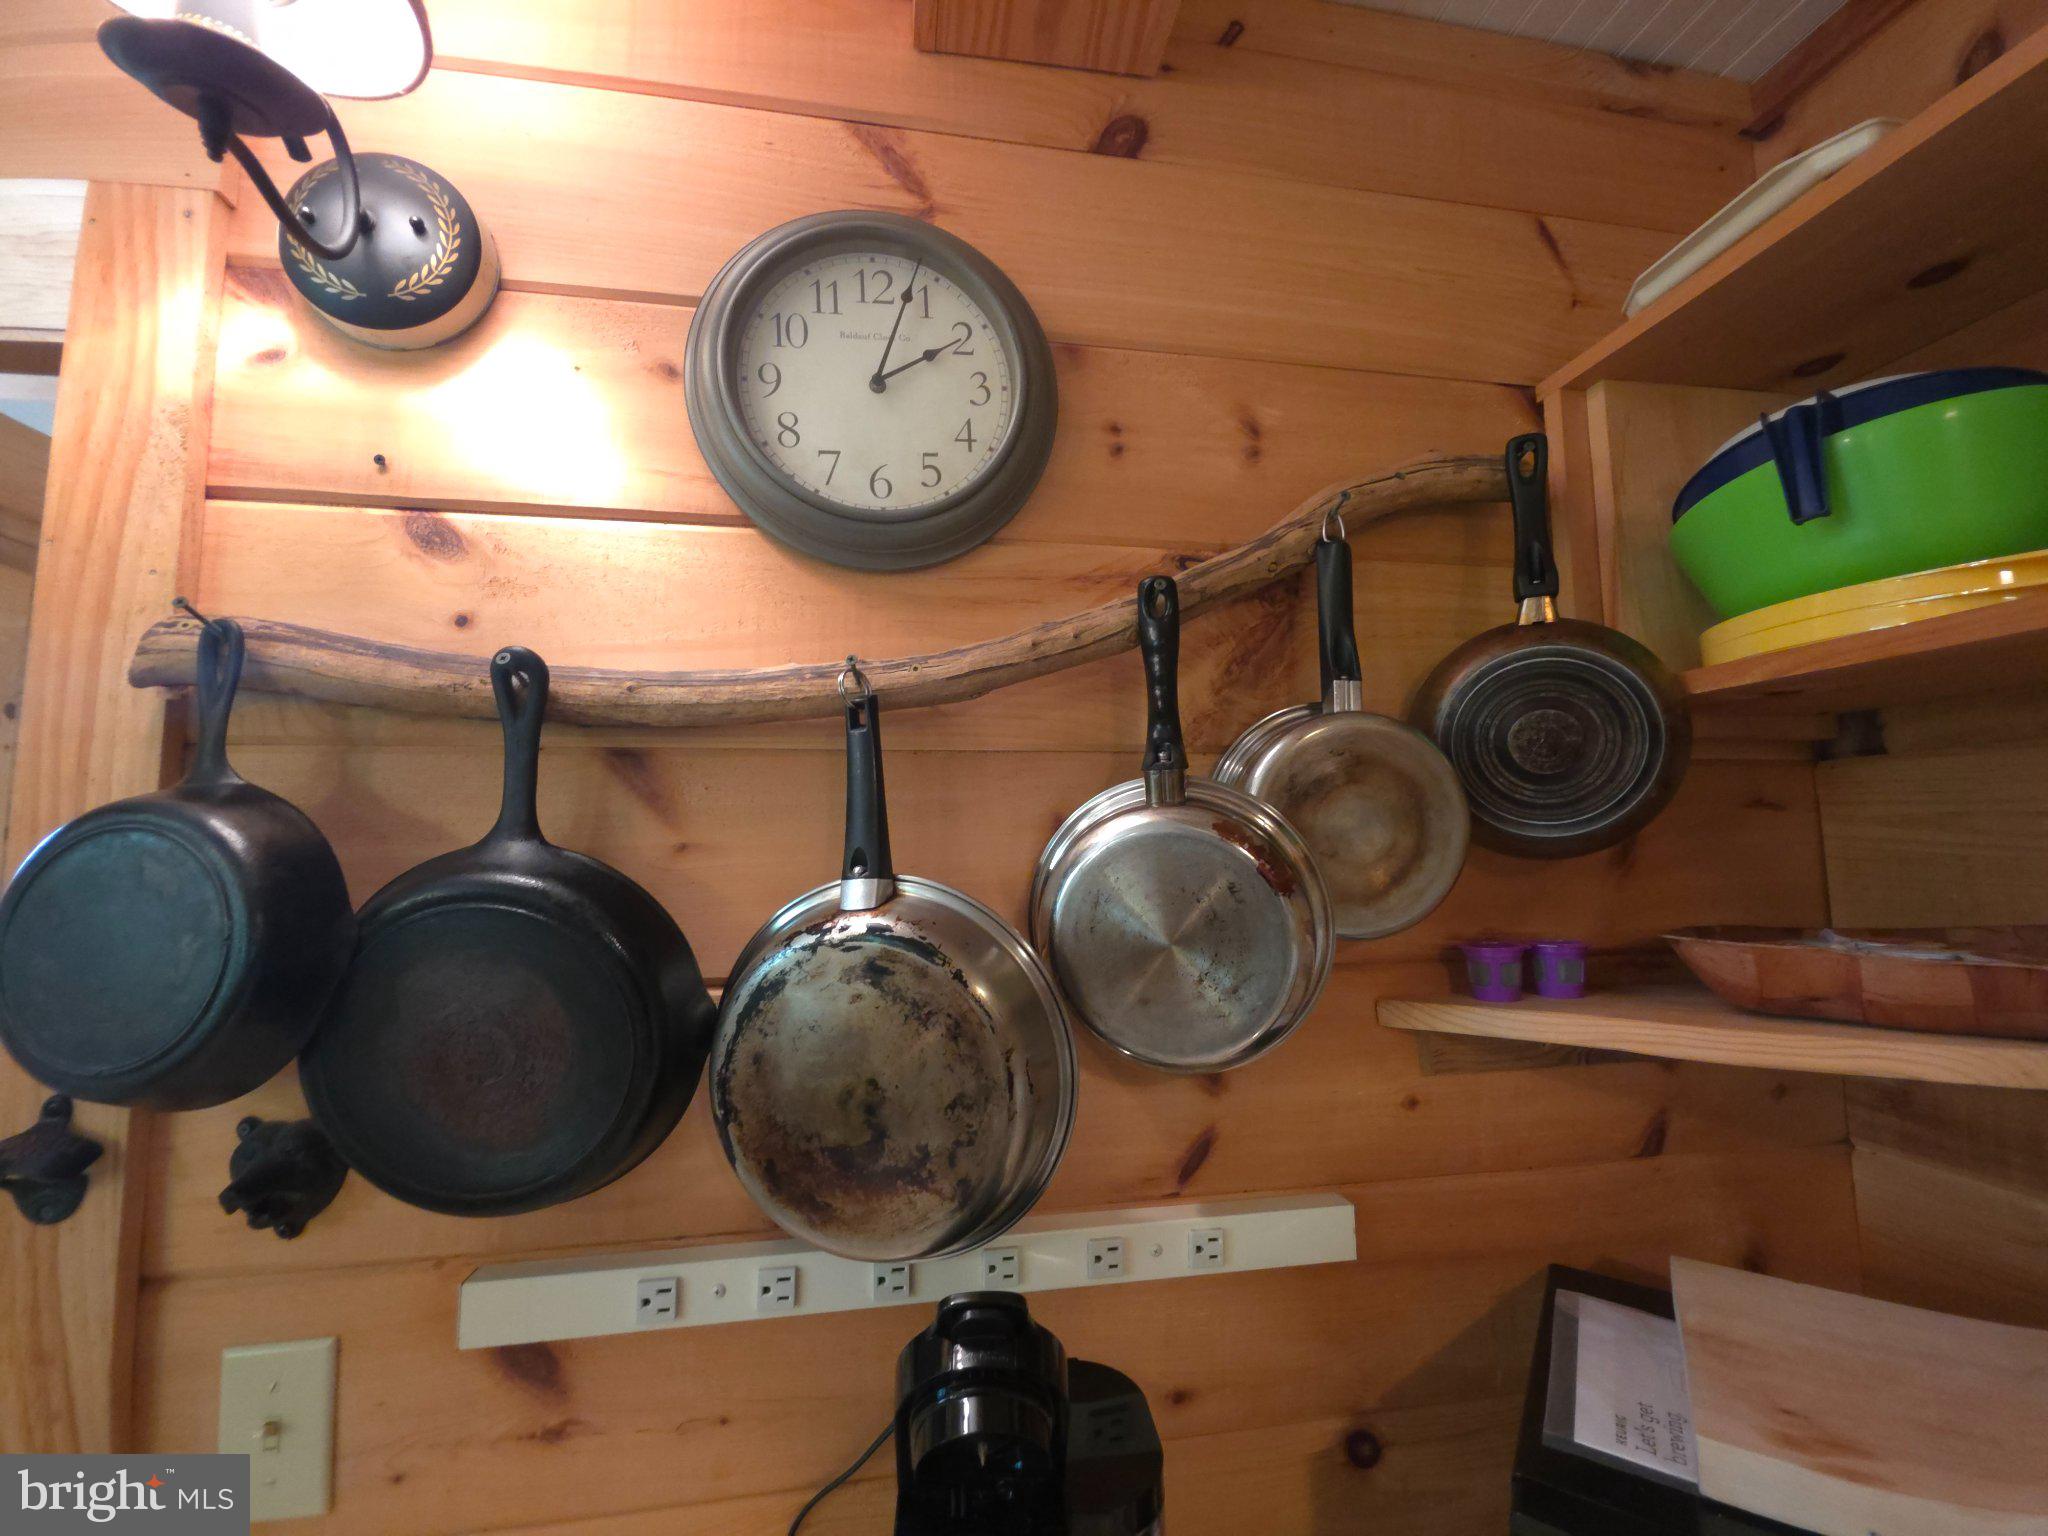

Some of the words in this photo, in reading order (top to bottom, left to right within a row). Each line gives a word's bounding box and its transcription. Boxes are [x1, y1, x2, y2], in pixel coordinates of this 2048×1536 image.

[808, 279, 844, 315] 11
[853, 269, 895, 305] 12
[917, 285, 934, 319] 1
[770, 312, 809, 349] 10
[951, 322, 975, 356] 2
[757, 362, 782, 398] 9
[969, 371, 991, 406] 3
[777, 411, 801, 448] 8
[954, 418, 977, 453] 4
[817, 450, 842, 485] 7
[869, 464, 893, 499] 6
[920, 452, 942, 488] 5
[1638, 1402, 1660, 1424] get
[1633, 1424, 1658, 1456] Let's
